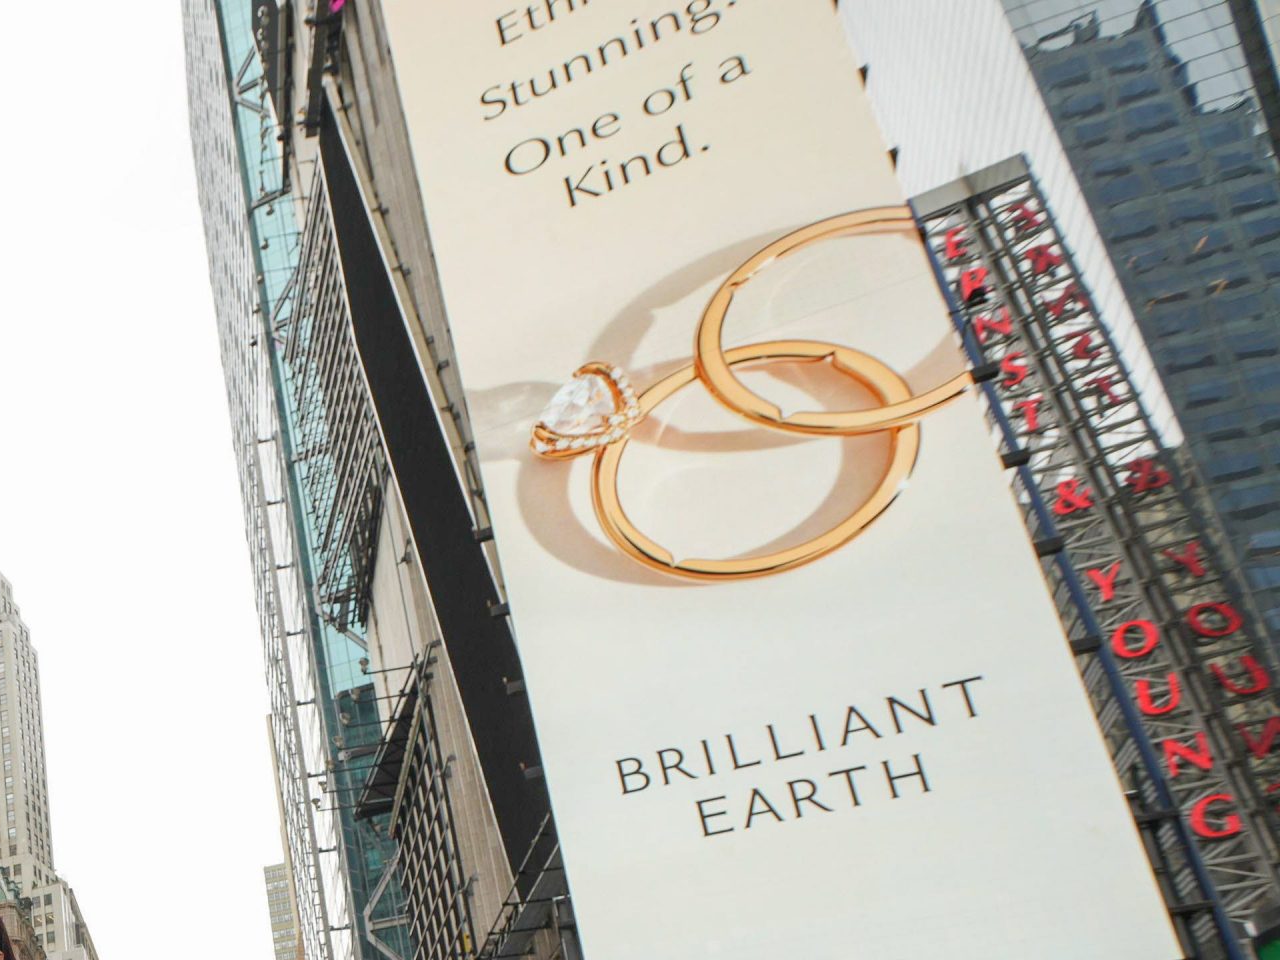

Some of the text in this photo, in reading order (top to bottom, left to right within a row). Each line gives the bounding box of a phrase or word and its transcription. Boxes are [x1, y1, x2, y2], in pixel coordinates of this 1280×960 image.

[480, 0, 737, 121] Stunning.
[504, 54, 753, 176] One of a
[564, 123, 711, 208] Kind.
[943, 225, 1243, 839] ERNST & YOUNG
[614, 676, 987, 796] BRILLIANT
[694, 753, 933, 839] EARTH
